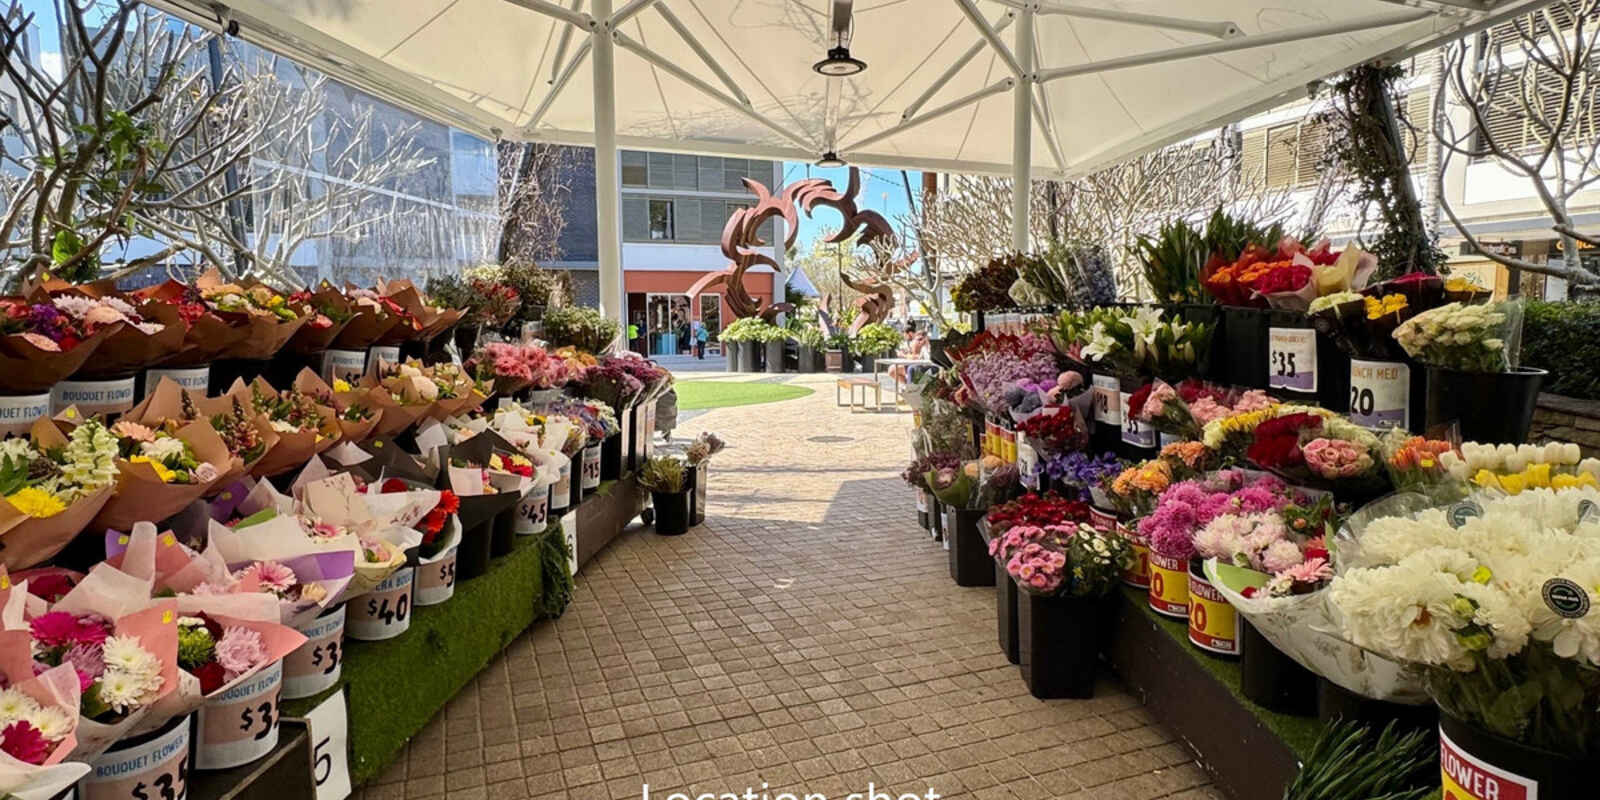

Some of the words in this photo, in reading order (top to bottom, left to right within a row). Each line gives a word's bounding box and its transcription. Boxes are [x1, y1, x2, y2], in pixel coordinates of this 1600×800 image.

[1272, 350, 1296, 377] $35
[63, 391, 104, 401] BOUQUET
[521, 503, 546, 524] $45
[368, 593, 408, 625] $40
[97, 757, 148, 777] BOUQUET
